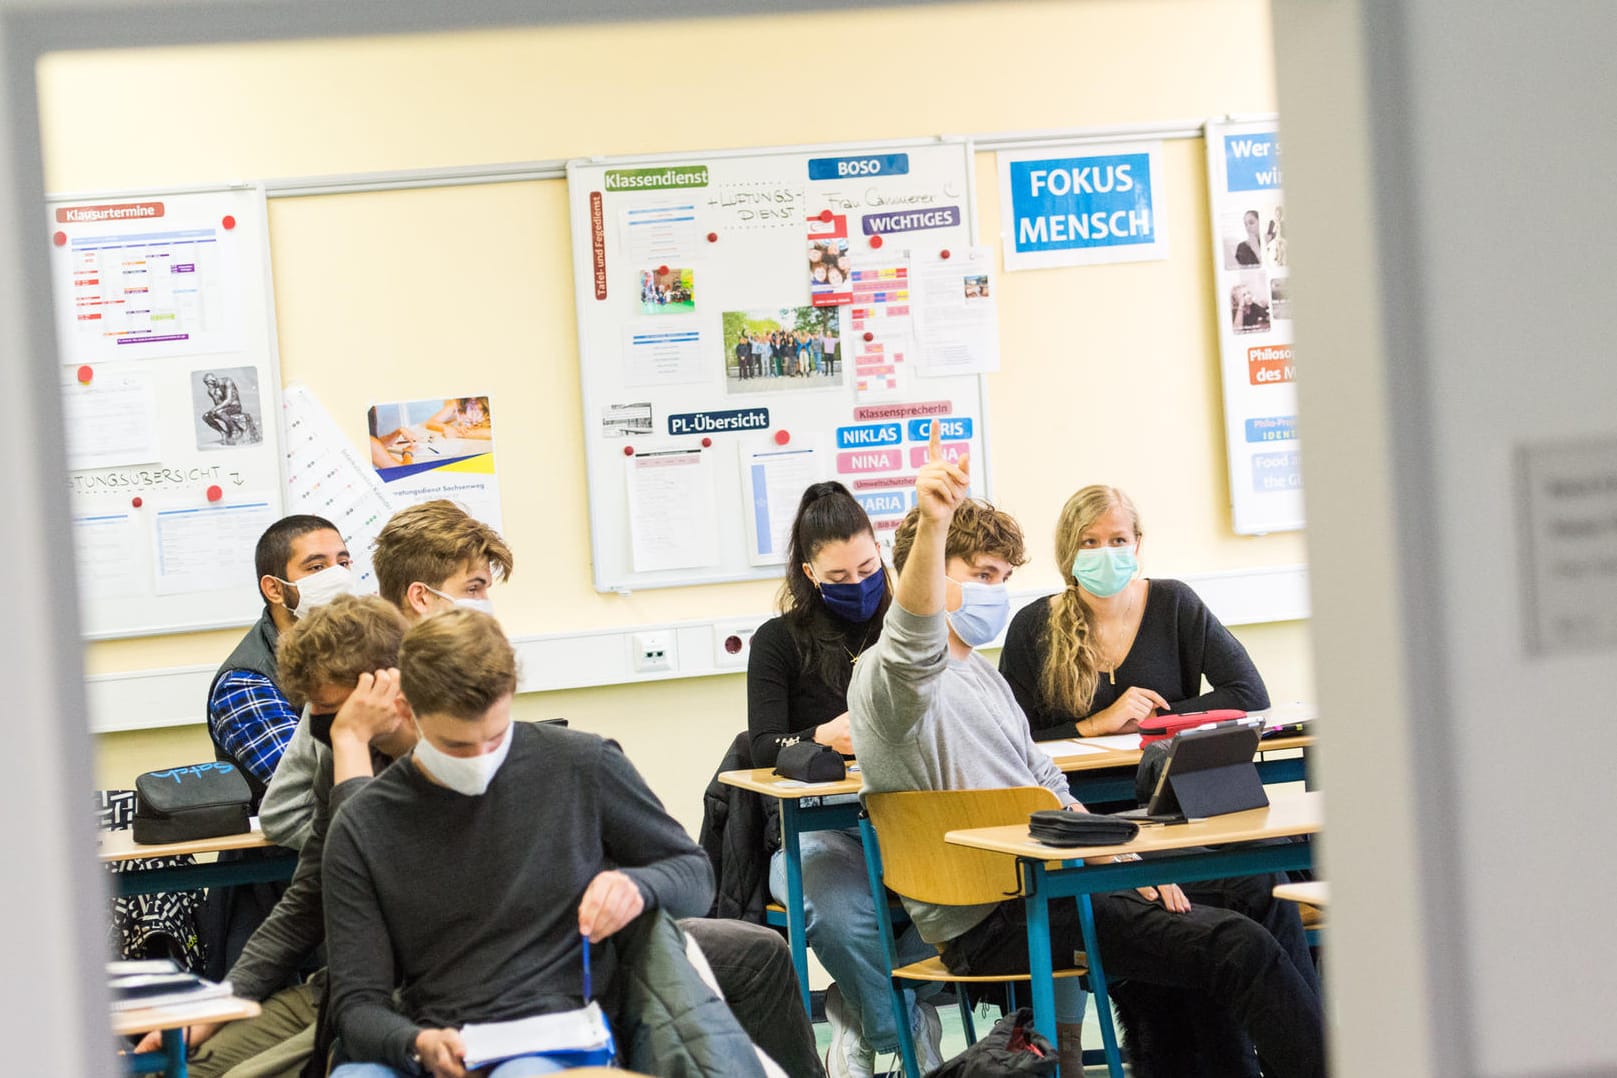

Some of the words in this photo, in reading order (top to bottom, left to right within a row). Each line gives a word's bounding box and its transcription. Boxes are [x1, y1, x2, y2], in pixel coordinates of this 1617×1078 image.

[1231, 140, 1271, 158] Wer
[838, 159, 881, 176] BOSO
[605, 169, 709, 188] Klassendienst
[1030, 164, 1133, 197] FOKUS
[66, 206, 155, 221] Klausurtermine
[592, 196, 604, 247] Fegedienst
[738, 207, 795, 221] DIENST
[869, 210, 953, 232] WICHTIGES
[1018, 209, 1150, 244] MENSCH
[594, 249, 605, 267] und
[595, 269, 606, 296] Tafel-
[1256, 367, 1282, 382] des
[859, 404, 948, 420] KlassensprecherIn
[671, 412, 767, 433] PL-Übersicht
[919, 422, 964, 437] CRIS
[842, 427, 898, 444] NIKLAS
[851, 454, 890, 469] NINA
